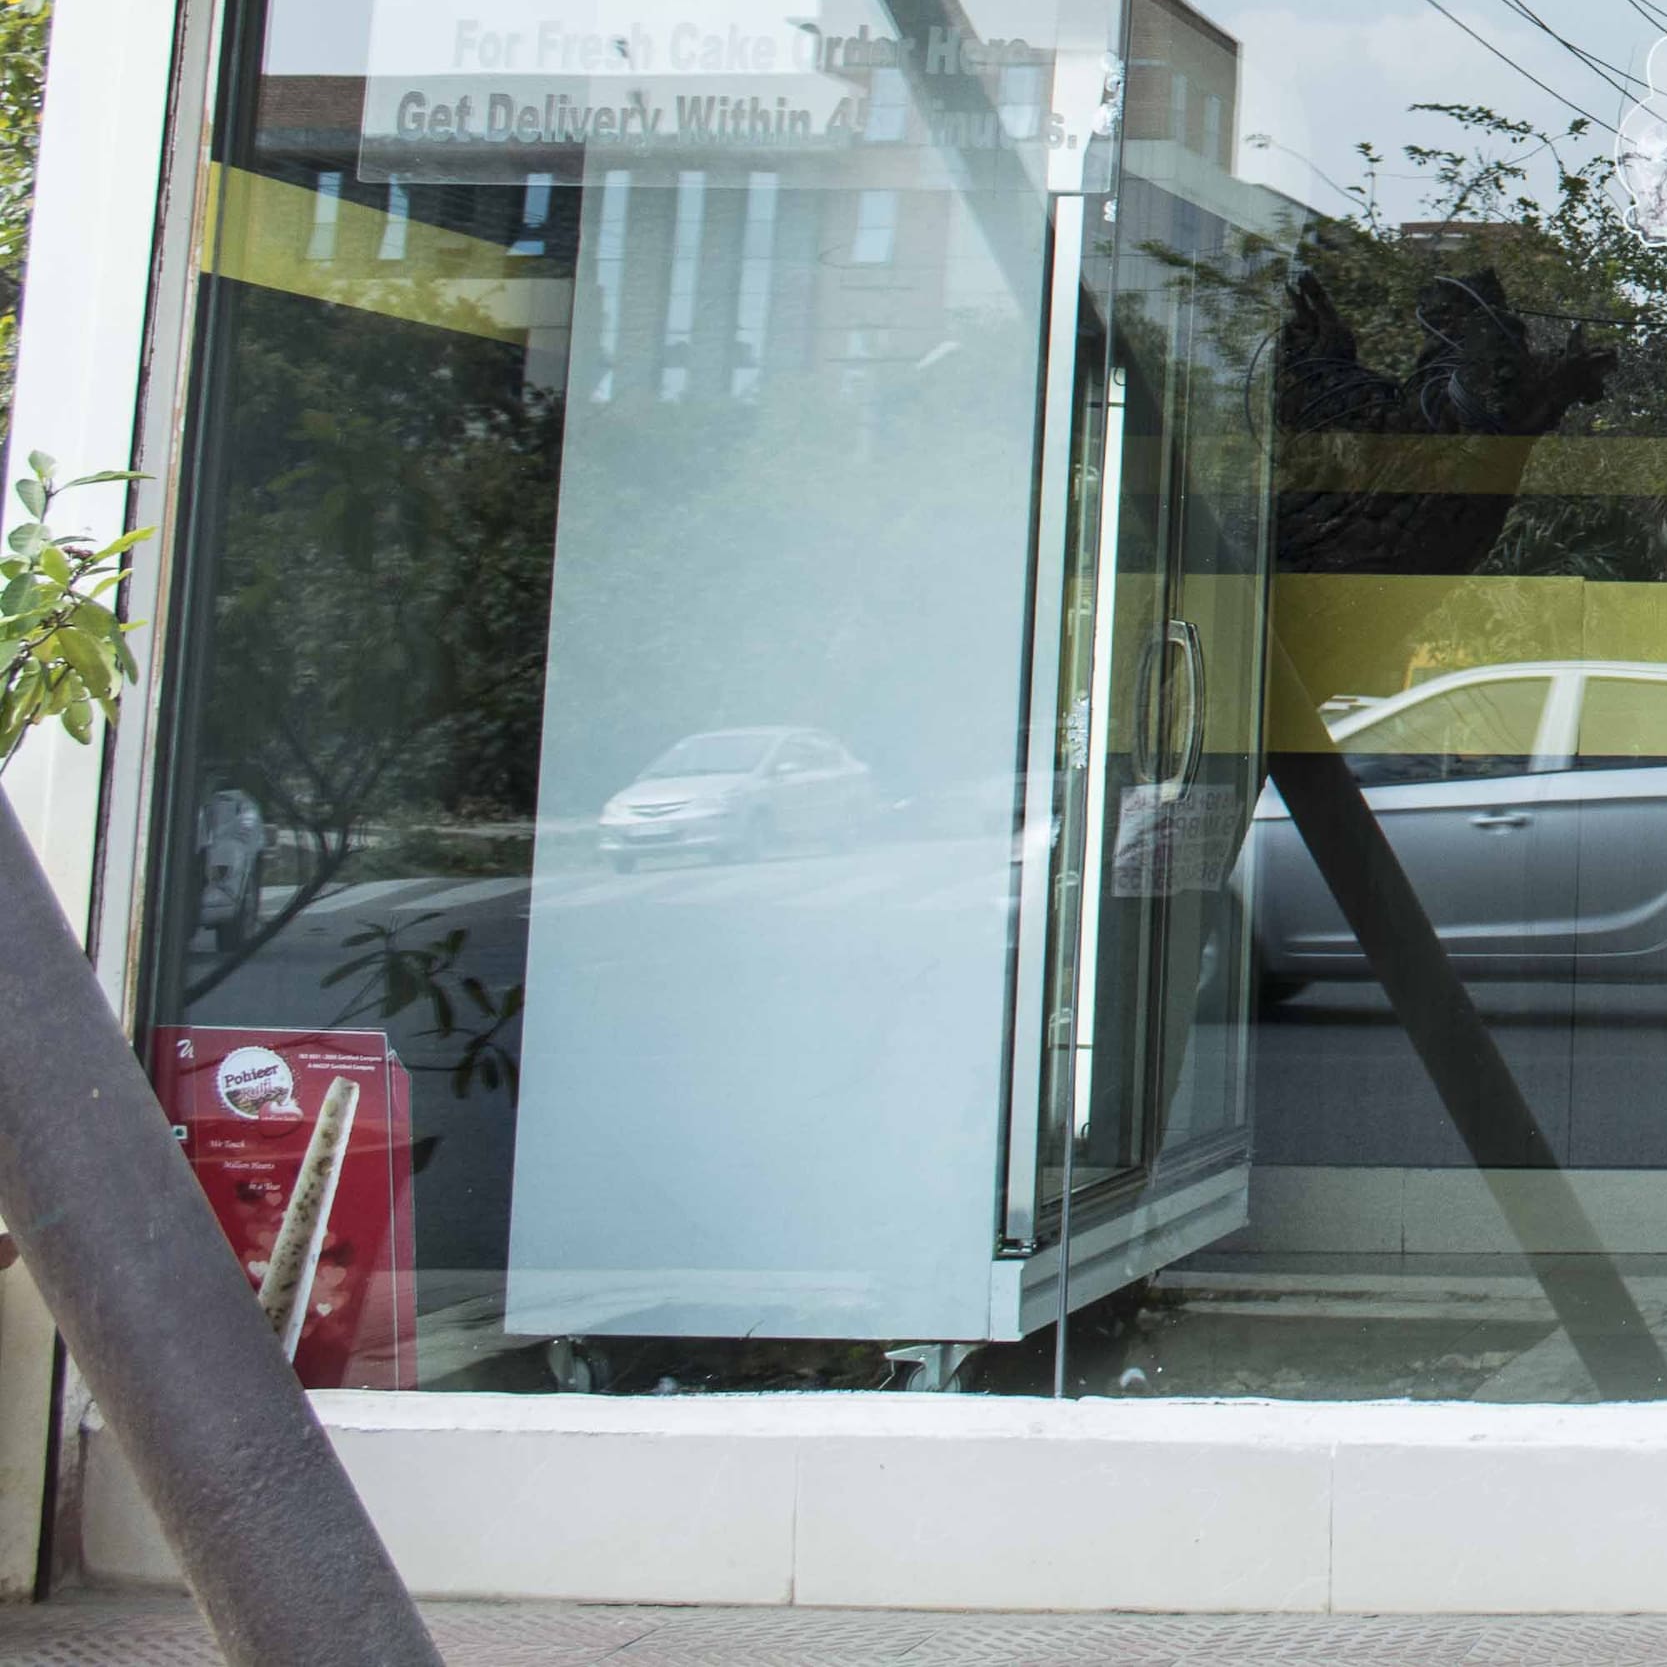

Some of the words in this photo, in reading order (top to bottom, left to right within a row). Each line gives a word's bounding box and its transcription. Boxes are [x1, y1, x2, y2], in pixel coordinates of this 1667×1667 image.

[453, 19, 521, 69] For
[536, 20, 654, 71] Fresh
[669, 21, 771, 72] Cake
[792, 24, 914, 73] Order
[396, 90, 472, 142] Get
[484, 92, 662, 156] Delivery
[676, 94, 811, 145] Within
